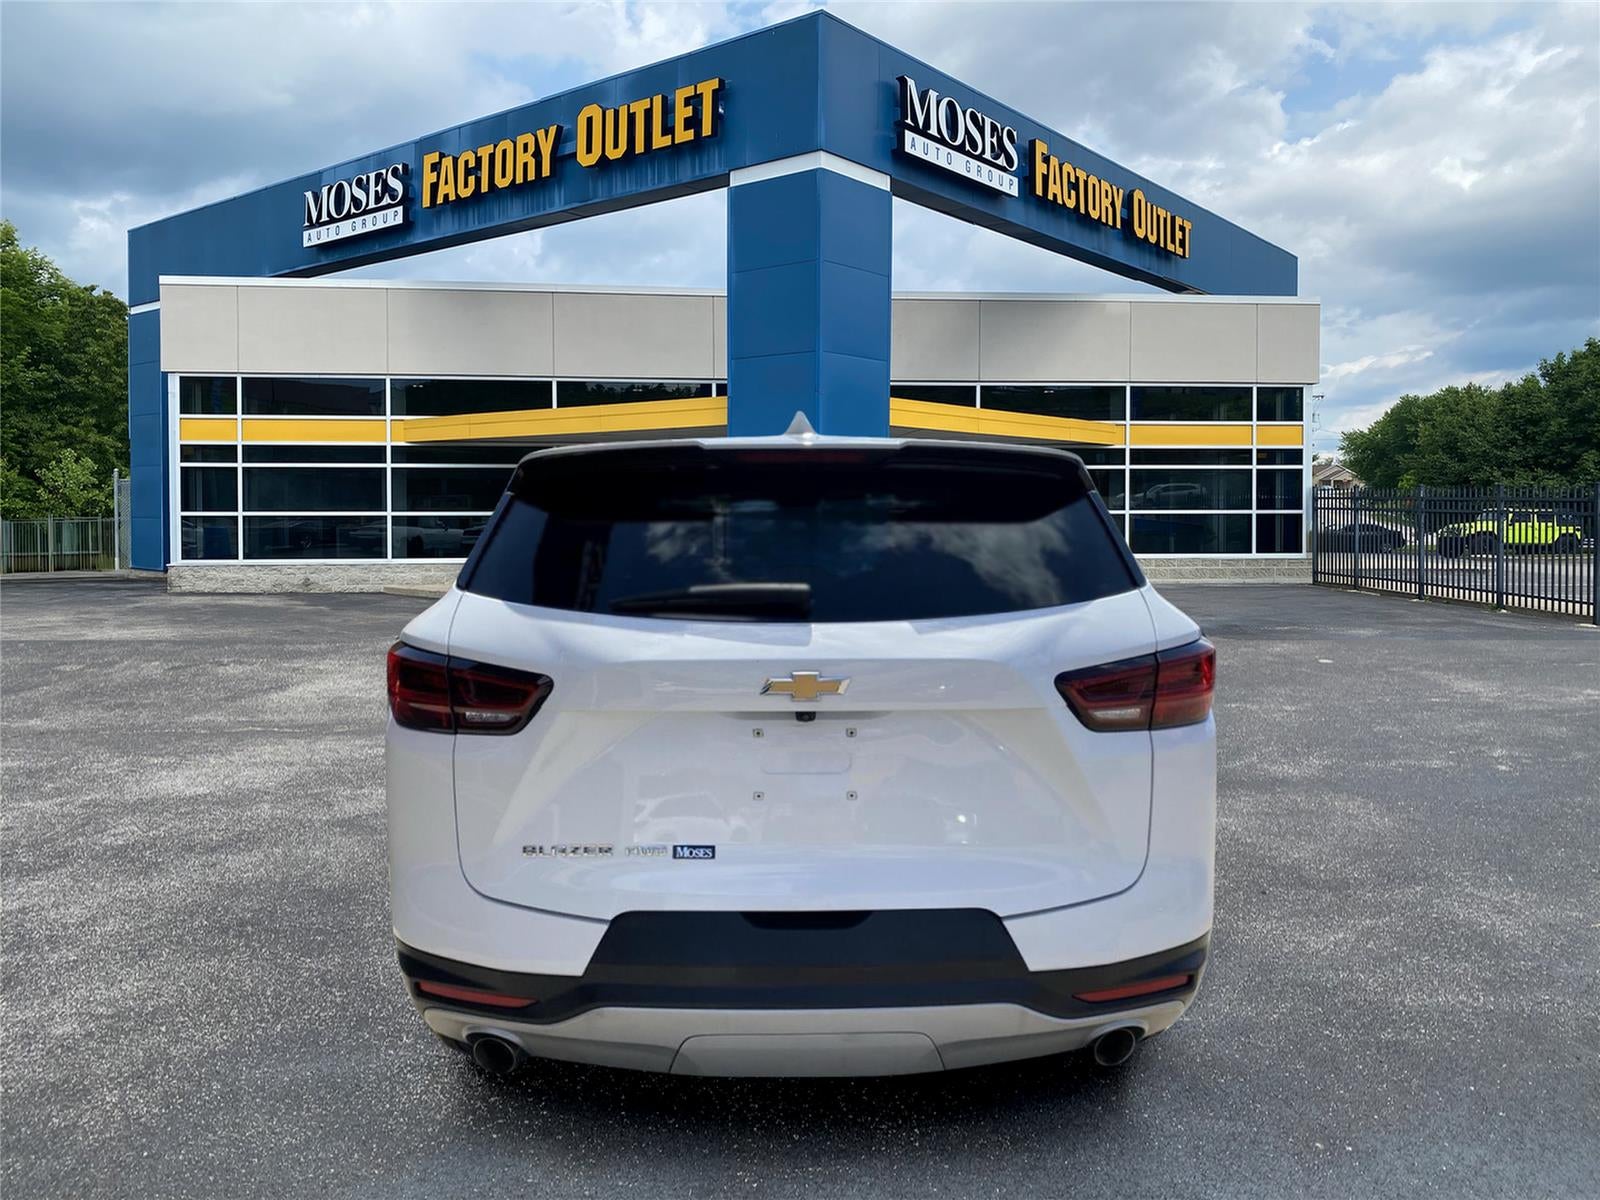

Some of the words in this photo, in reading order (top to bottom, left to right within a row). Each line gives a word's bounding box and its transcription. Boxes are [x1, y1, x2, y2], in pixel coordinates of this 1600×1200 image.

[422, 124, 558, 208] FACTORY
[576, 78, 720, 168] OUTLET
[904, 75, 1019, 171] MOSES
[303, 163, 404, 226] MOSES
[910, 136, 953, 166] AUTO
[965, 160, 1015, 191] GROUP
[307, 227, 341, 244] AUTO
[351, 210, 400, 231] GROUP
[1034, 138, 1124, 230] FACTORY
[1132, 188, 1193, 259] OUTLET
[522, 845, 614, 857] BLAZER
